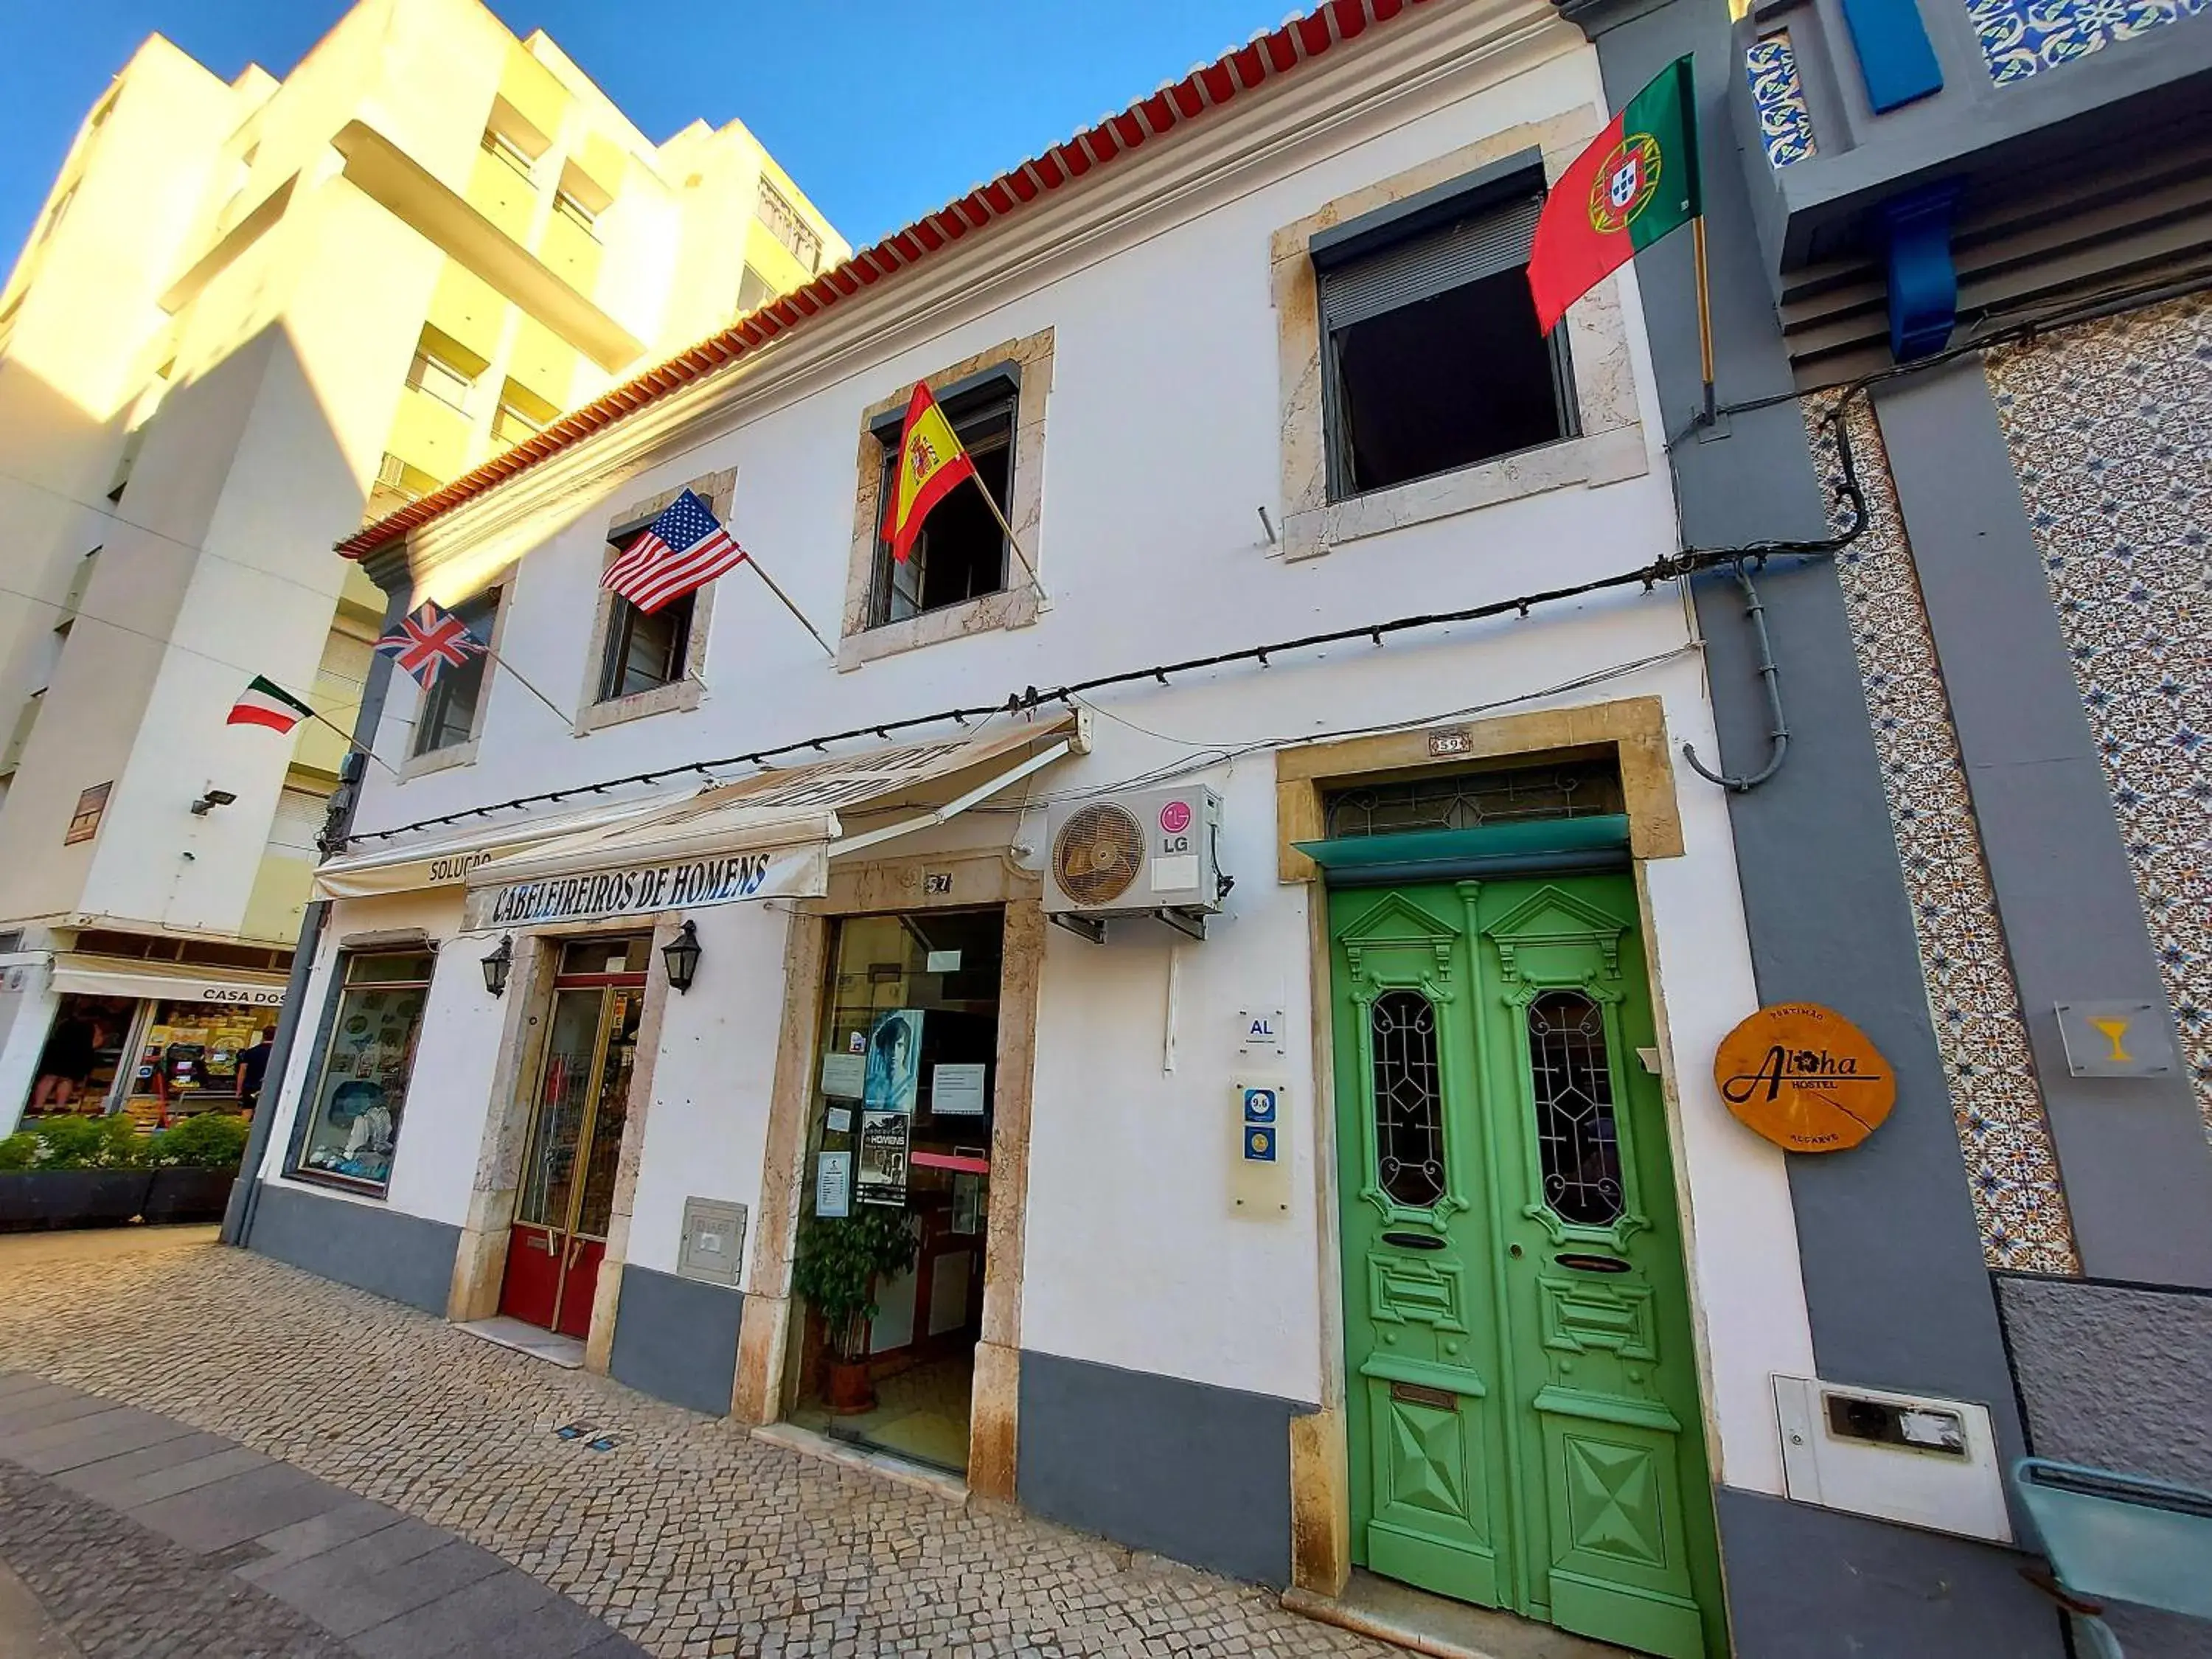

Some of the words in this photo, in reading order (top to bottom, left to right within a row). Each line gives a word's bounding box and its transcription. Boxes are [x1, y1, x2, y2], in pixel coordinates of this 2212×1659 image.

[1164, 837, 1188, 853] LG
[493, 871, 639, 922] CABELEIREIROS
[634, 868, 669, 908] DE
[668, 853, 771, 905] HOMENS
[203, 989, 249, 1002] CASA
[1250, 1020, 1274, 1034] AL
[1792, 1080, 1838, 1090] HOSTEL
